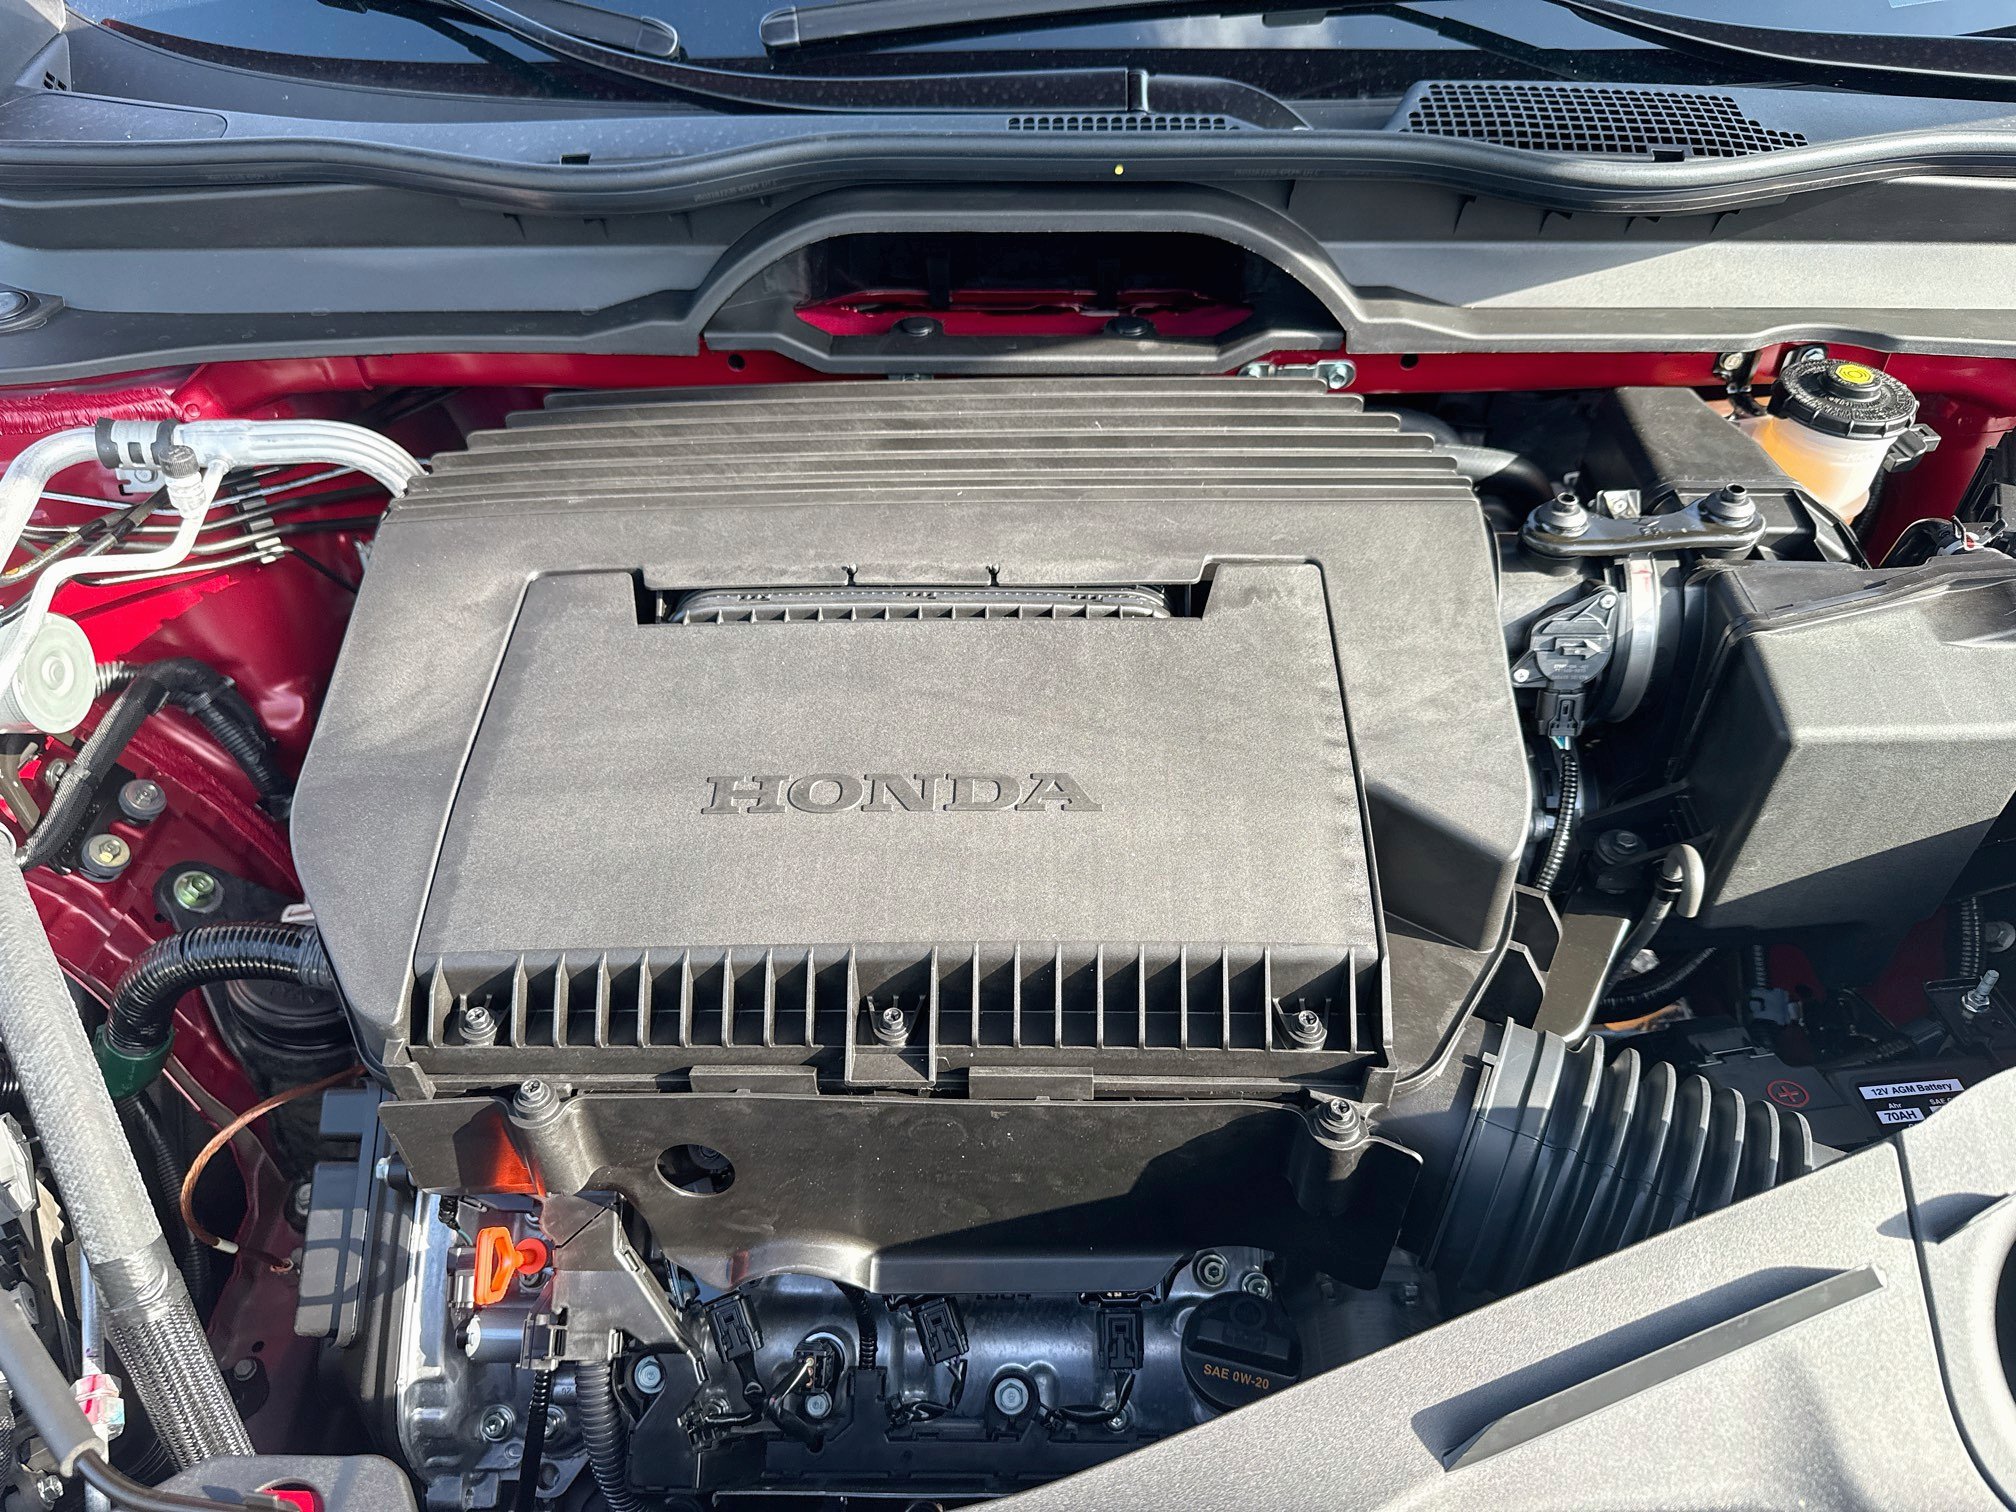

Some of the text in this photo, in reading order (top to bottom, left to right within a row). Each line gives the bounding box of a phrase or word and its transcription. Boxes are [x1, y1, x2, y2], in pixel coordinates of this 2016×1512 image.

[701, 772, 1104, 814] HONDA
[1871, 1083, 1952, 1096] 12V AGM Battery
[1884, 1110, 1917, 1121] 70AH
[1203, 1363, 1270, 1389] SAE 0W-20
